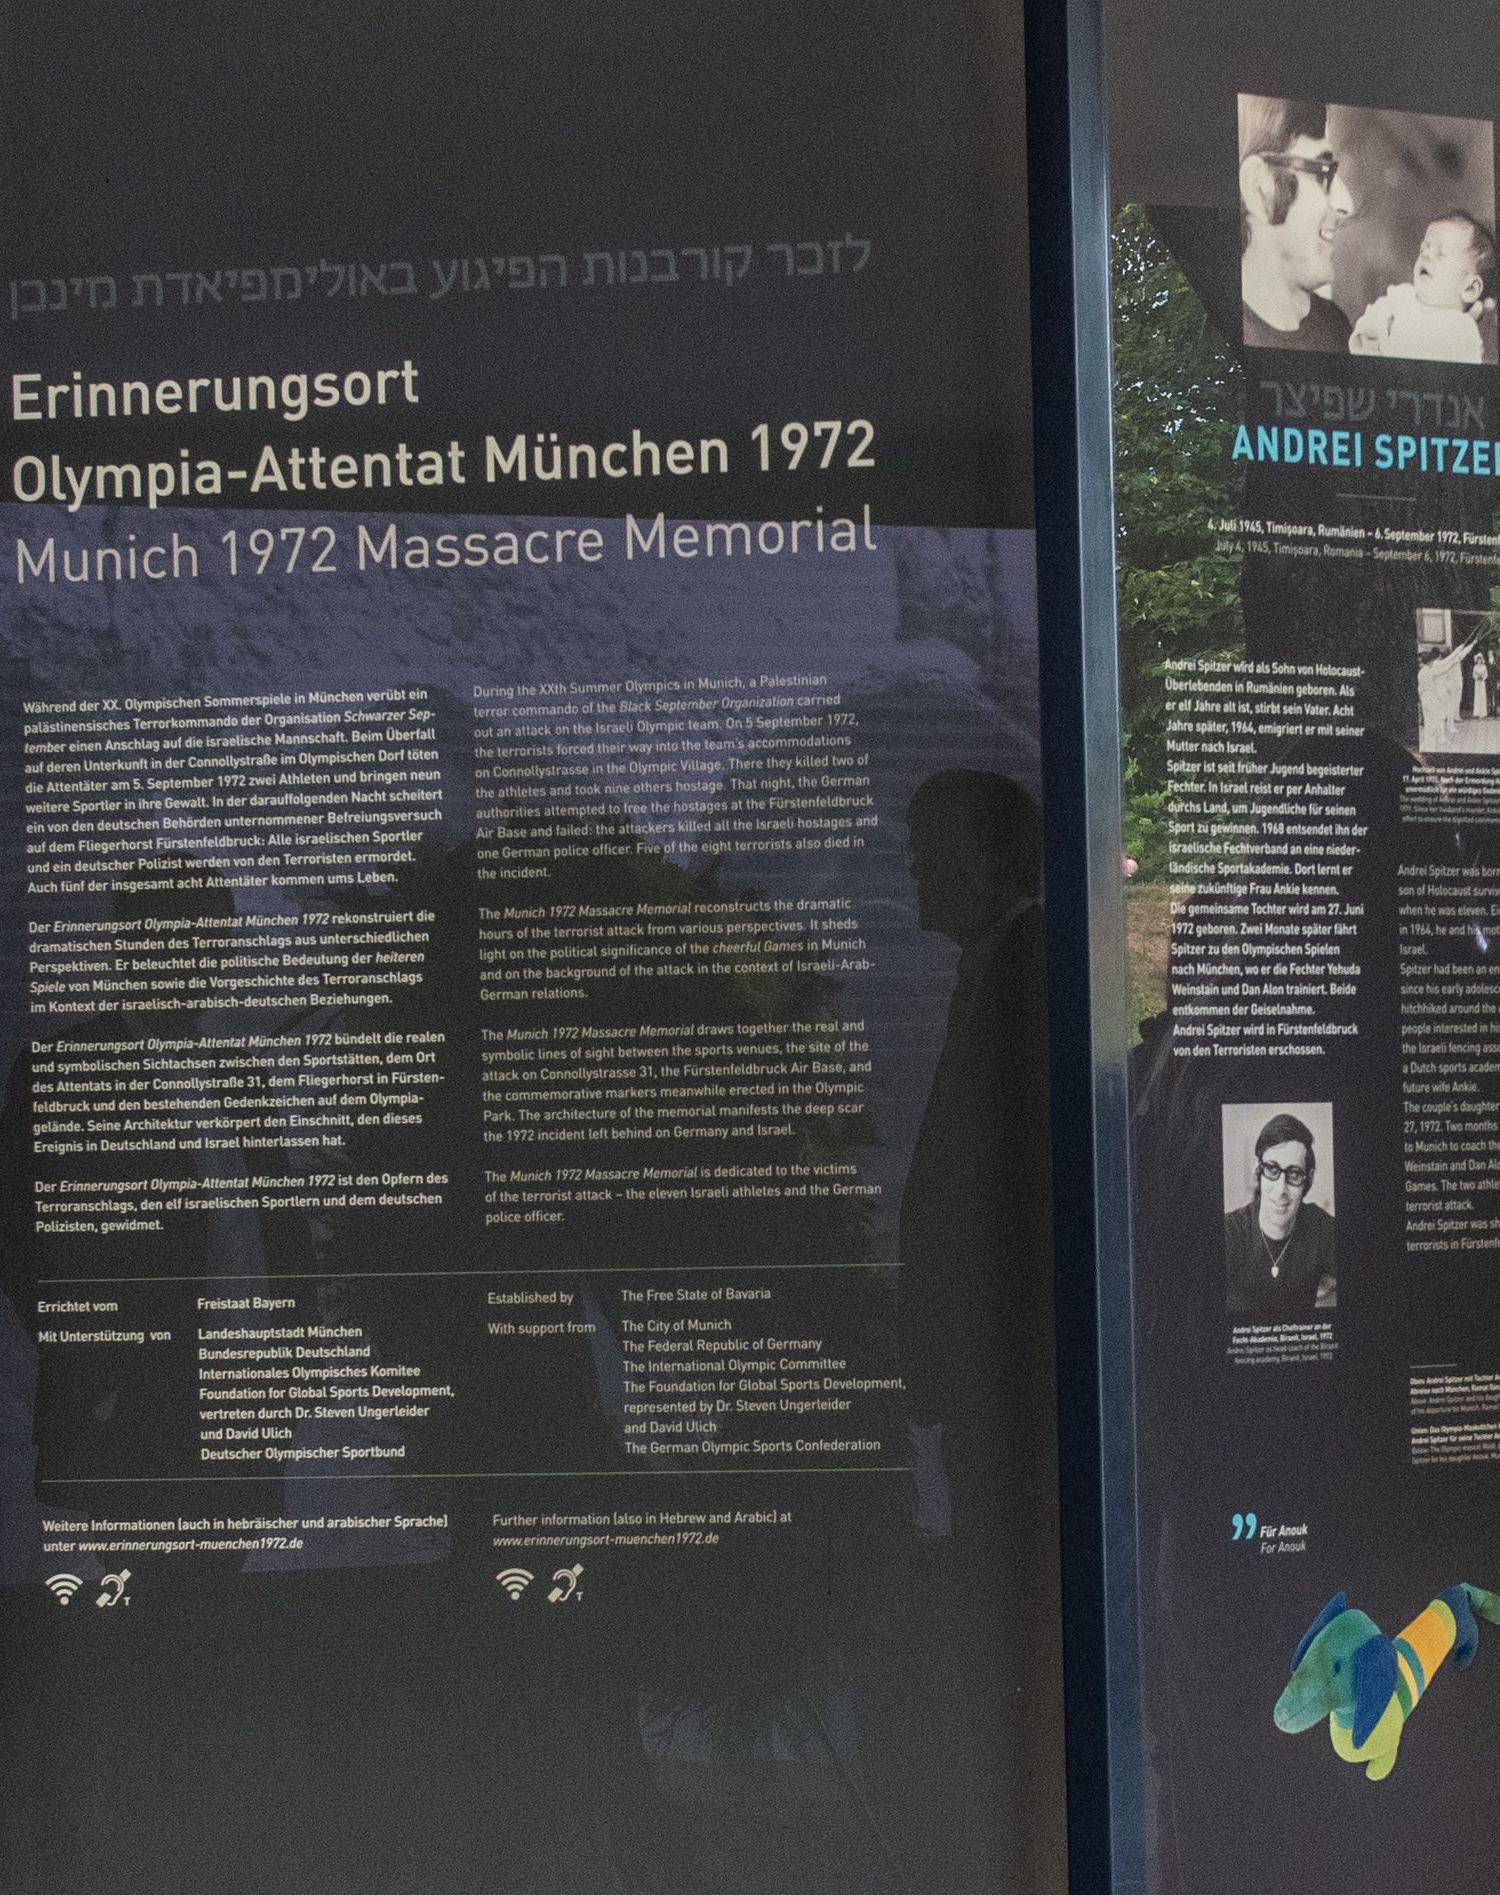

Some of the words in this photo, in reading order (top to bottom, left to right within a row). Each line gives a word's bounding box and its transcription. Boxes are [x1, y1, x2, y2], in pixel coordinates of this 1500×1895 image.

[766, 232, 872, 278] לזכר
[429, 252, 568, 301] הפיגוע
[581, 243, 755, 291] קורבנות
[132, 258, 417, 309] באולימפיאדת
[11, 272, 118, 319] מינכן
[11, 360, 419, 421] Erinnerungsort
[1231, 424, 1362, 468] ANDREI
[12, 437, 466, 511] Olympia-Attentat
[486, 428, 729, 483] München
[752, 420, 877, 471] 1972
[1208, 518, 1217, 530] 4.
[1219, 519, 1237, 531] Juli
[1239, 520, 1263, 534] 1945,
[1317, 524, 1365, 538] Rumänien
[1374, 527, 1383, 539] 6.
[1384, 528, 1434, 544] September
[1437, 530, 1460, 544] 1972,
[17, 531, 198, 584] Munich
[221, 527, 337, 575] 1972
[358, 517, 603, 570] Massacre
[626, 505, 877, 561] Memorial
[1165, 658, 1196, 671] Andrei
[1197, 659, 1230, 675] Spitzer
[1233, 660, 1254, 672] wird
[1255, 661, 1270, 673] als
[1271, 661, 1295, 674] Sohn
[1297, 664, 1313, 674] von
[1315, 662, 1365, 676] Holocaust-
[473, 684, 514, 700] During
[516, 683, 536, 696] the
[539, 682, 566, 695] XXth
[569, 680, 621, 694] Summer
[625, 678, 680, 695] Olympics
[683, 678, 694, 690] in
[697, 676, 745, 691] Munich,
[749, 679, 756, 688] a
[759, 674, 827, 688] Palestinian
[23, 700, 76, 714] Während
[79, 699, 98, 712] der
[102, 699, 121, 711] XX.
[124, 696, 201, 713] Olympischen
[203, 693, 291, 711] Sommerspiele
[293, 692, 305, 704] in
[308, 690, 363, 704] München
[366, 689, 405, 702] verübt
[408, 688, 427, 701] ein
[23, 718, 130, 736] palästinensisches
[133, 714, 237, 729] Terrorkommando
[240, 714, 260, 726] der
[264, 711, 341, 729] Organisation
[343, 709, 405, 723] Schwarzer
[408, 708, 435, 724] Sep-
[479, 907, 500, 920] The
[503, 906, 545, 919] Munich
[550, 905, 575, 918] 1972
[578, 904, 633, 917] Massacre
[636, 902, 691, 915] Memorial
[694, 900, 770, 914] reconstructs
[773, 899, 793, 911] the
[796, 897, 851, 911] dramatic
[1171, 902, 1186, 914] Die
[1188, 902, 1249, 918] gemeinsame
[1251, 903, 1286, 915] Tochter
[1288, 903, 1309, 915] wird
[1311, 906, 1326, 915] am
[1327, 903, 1342, 915] 27.
[1344, 903, 1365, 915] Juni
[29, 920, 49, 932] Der
[53, 918, 141, 935] Erinnerungsort
[144, 915, 242, 932] Olympia-Attentat
[245, 914, 298, 927] München
[302, 913, 329, 925] 1972
[331, 911, 413, 925] rekonstruiert
[416, 910, 435, 922] die
[34, 1139, 82, 1155] Ereignis
[85, 1139, 97, 1151] in
[99, 1137, 176, 1151] Deutschland
[178, 1137, 201, 1149] und
[204, 1136, 239, 1149] Israel
[242, 1135, 319, 1148] hinterlassen
[321, 1134, 345, 1146] hat.
[36, 1219, 97, 1234] Polizisten,
[100, 1218, 163, 1234] gewidmet.
[197, 1297, 250, 1309] Freistaat
[252, 1296, 296, 1311] Bayern
[487, 1291, 556, 1303] Established
[559, 1290, 574, 1305] by
[621, 1289, 643, 1301] The
[646, 1289, 673, 1301] Free
[676, 1288, 707, 1300] State
[710, 1288, 722, 1300] of
[725, 1287, 771, 1300] Bavaria
[38, 1300, 90, 1312] Errichtet
[92, 1302, 118, 1311] vom
[198, 1326, 304, 1342] Landeshauptstadt
[307, 1325, 362, 1338] München
[622, 1319, 644, 1331] The
[646, 1319, 669, 1334] City
[672, 1319, 684, 1331] of
[687, 1318, 732, 1331] Munich
[199, 1366, 289, 1379] Internationales
[291, 1365, 367, 1381] Olympisches
[369, 1365, 420, 1377] Komitee
[201, 1447, 261, 1459] Deutscher
[264, 1446, 338, 1462] Olympischer
[341, 1446, 405, 1461] Sportbund
[493, 1532, 719, 1549] www.erinnerungsort-muenchen1972.de
[1260, 1525, 1277, 1538] Für
[1278, 1523, 1308, 1536] Anouk
[44, 1540, 75, 1552] unter
[78, 1537, 303, 1554] www.erinnerungsort-muenchen1972.de
[1261, 1541, 1276, 1553] For
[1278, 1540, 1306, 1552] Anouk
